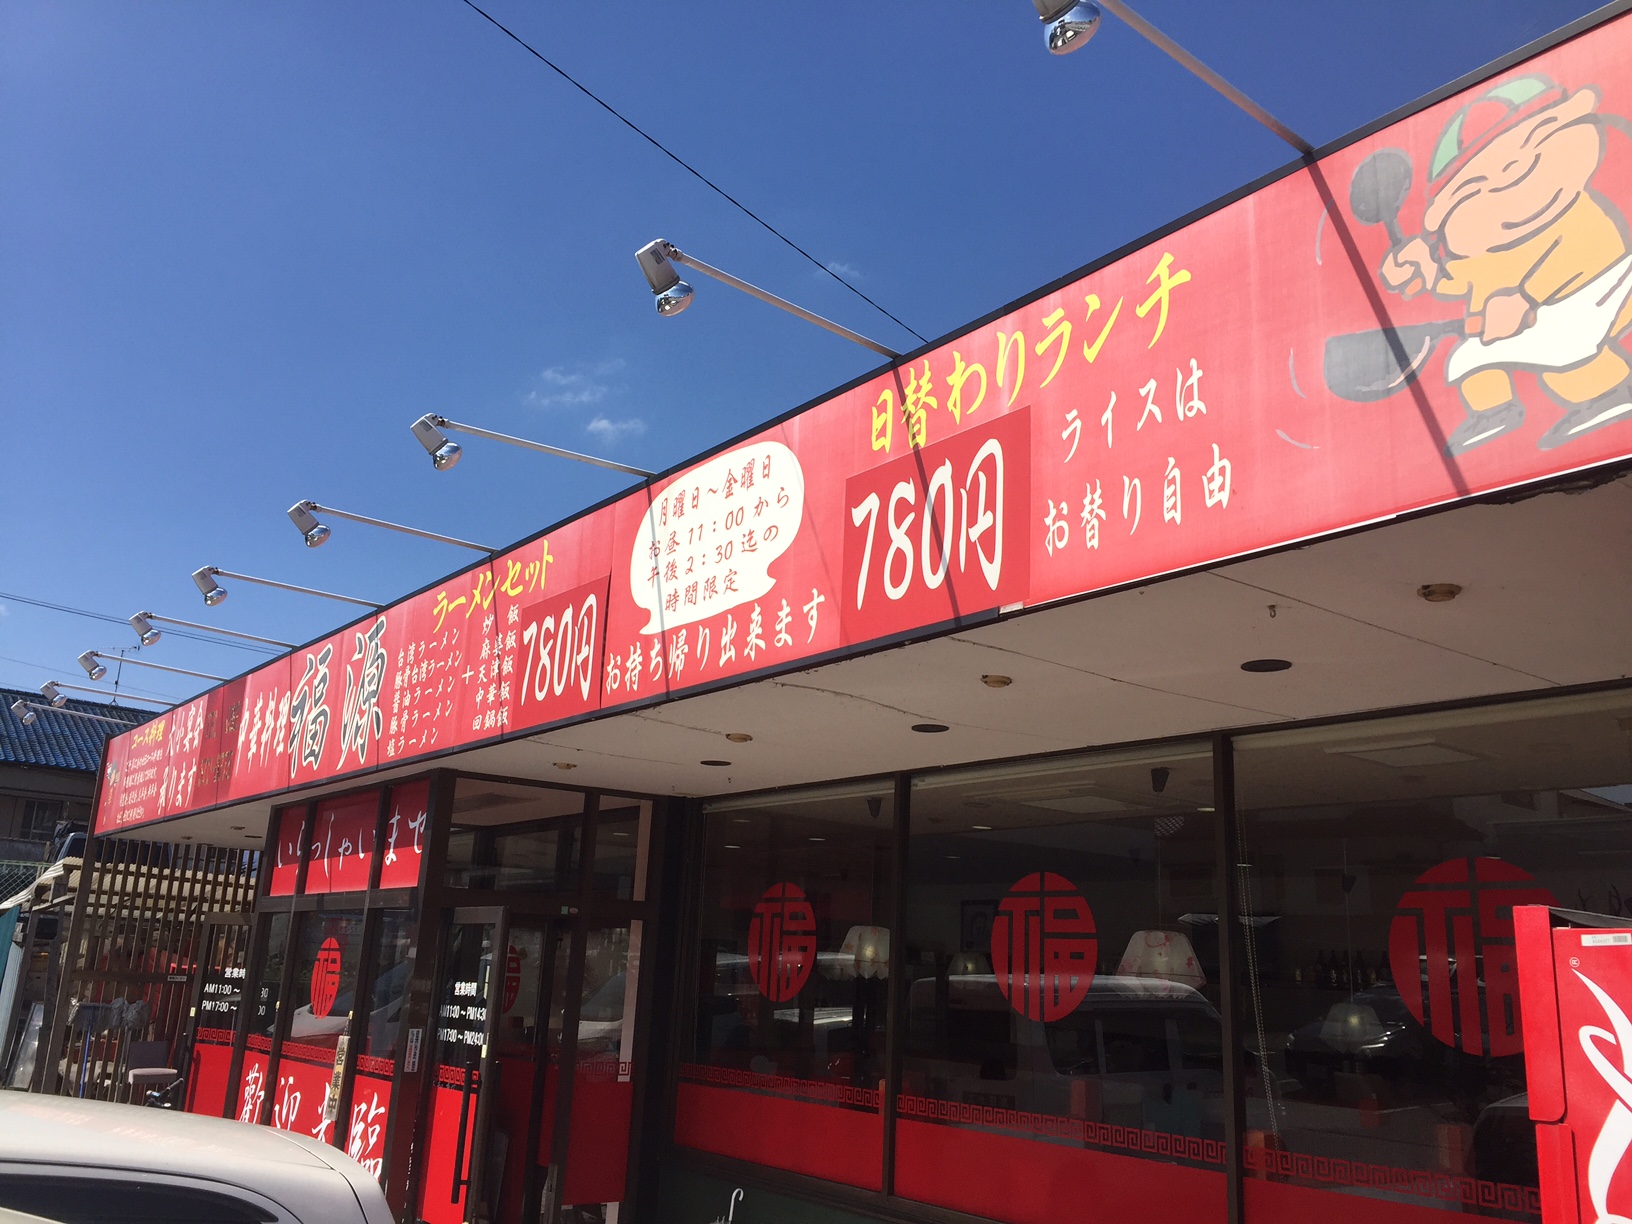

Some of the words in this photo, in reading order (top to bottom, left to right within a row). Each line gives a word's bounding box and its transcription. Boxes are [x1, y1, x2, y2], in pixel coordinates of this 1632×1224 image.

[871, 252, 1191, 453] 日替わりランチ
[1061, 358, 1207, 463] ライスは
[658, 454, 771, 527] 月曜日～金曜日
[851, 438, 1004, 610] 780円
[1043, 443, 1232, 557] お替り自由
[432, 539, 554, 633] ラーメンセット
[665, 568, 739, 612] 時間限定
[394, 650, 463, 690] 豚骨台湾ラーメン
[397, 628, 460, 668] 台湾ラーメン
[477, 655, 514, 684] 天津飯
[521, 593, 597, 706] 780円
[606, 588, 826, 695] お持ち帰り出来ます
[389, 700, 454, 735] 豚骨ラーメン
[475, 681, 511, 709] 中華飯
[131, 720, 166, 749] コース料理
[235, 687, 291, 777] 中華料理
[224, 967, 246, 979] 営業時
[454, 981, 478, 997] 営業時間
[327, 1046, 346, 1117] 営業中
